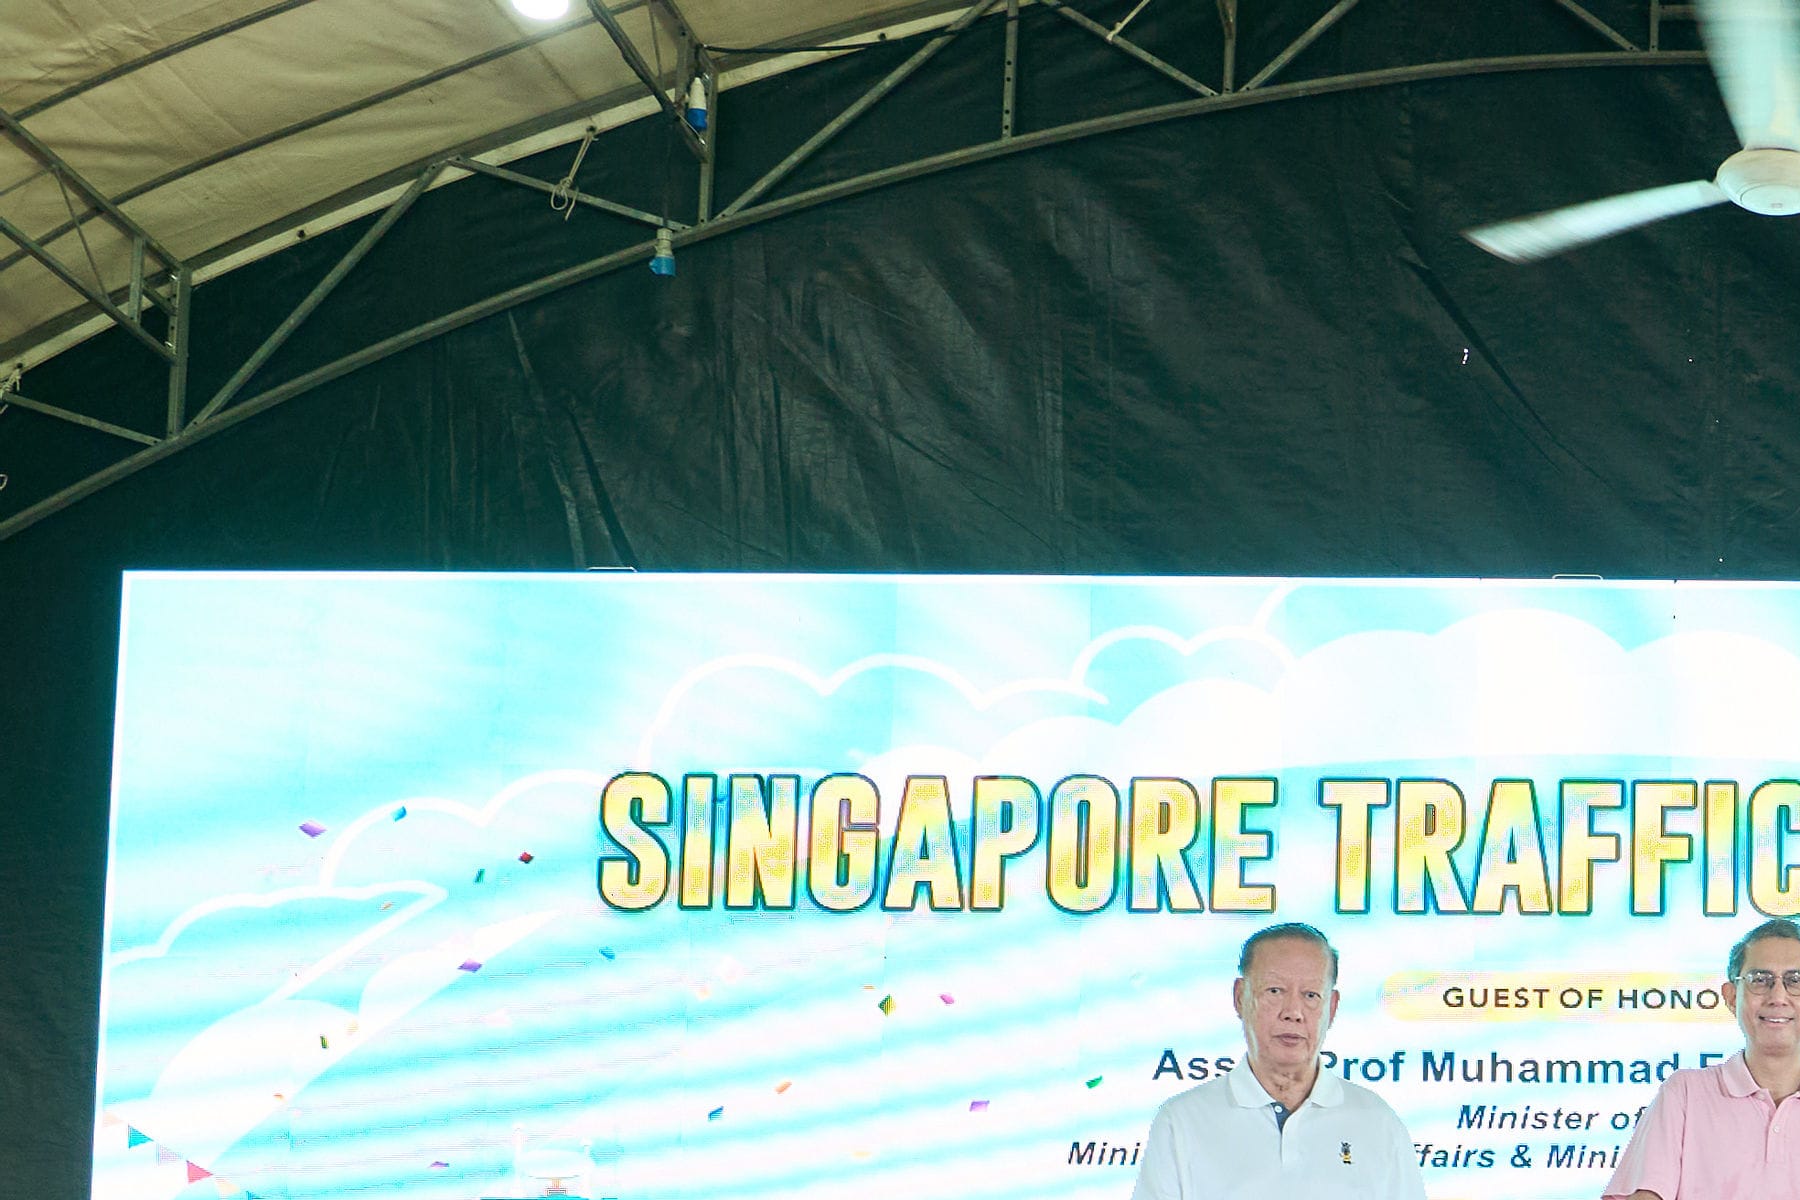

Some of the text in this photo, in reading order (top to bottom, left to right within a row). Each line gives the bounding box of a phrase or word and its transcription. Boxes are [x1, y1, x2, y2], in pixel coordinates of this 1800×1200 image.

[598, 771, 1278, 914] SINGAPORE
[1443, 987, 1719, 1009] GUEST OF HONO
[1457, 1104, 1599, 1130] Minister
[1510, 1144, 1532, 1168] &
